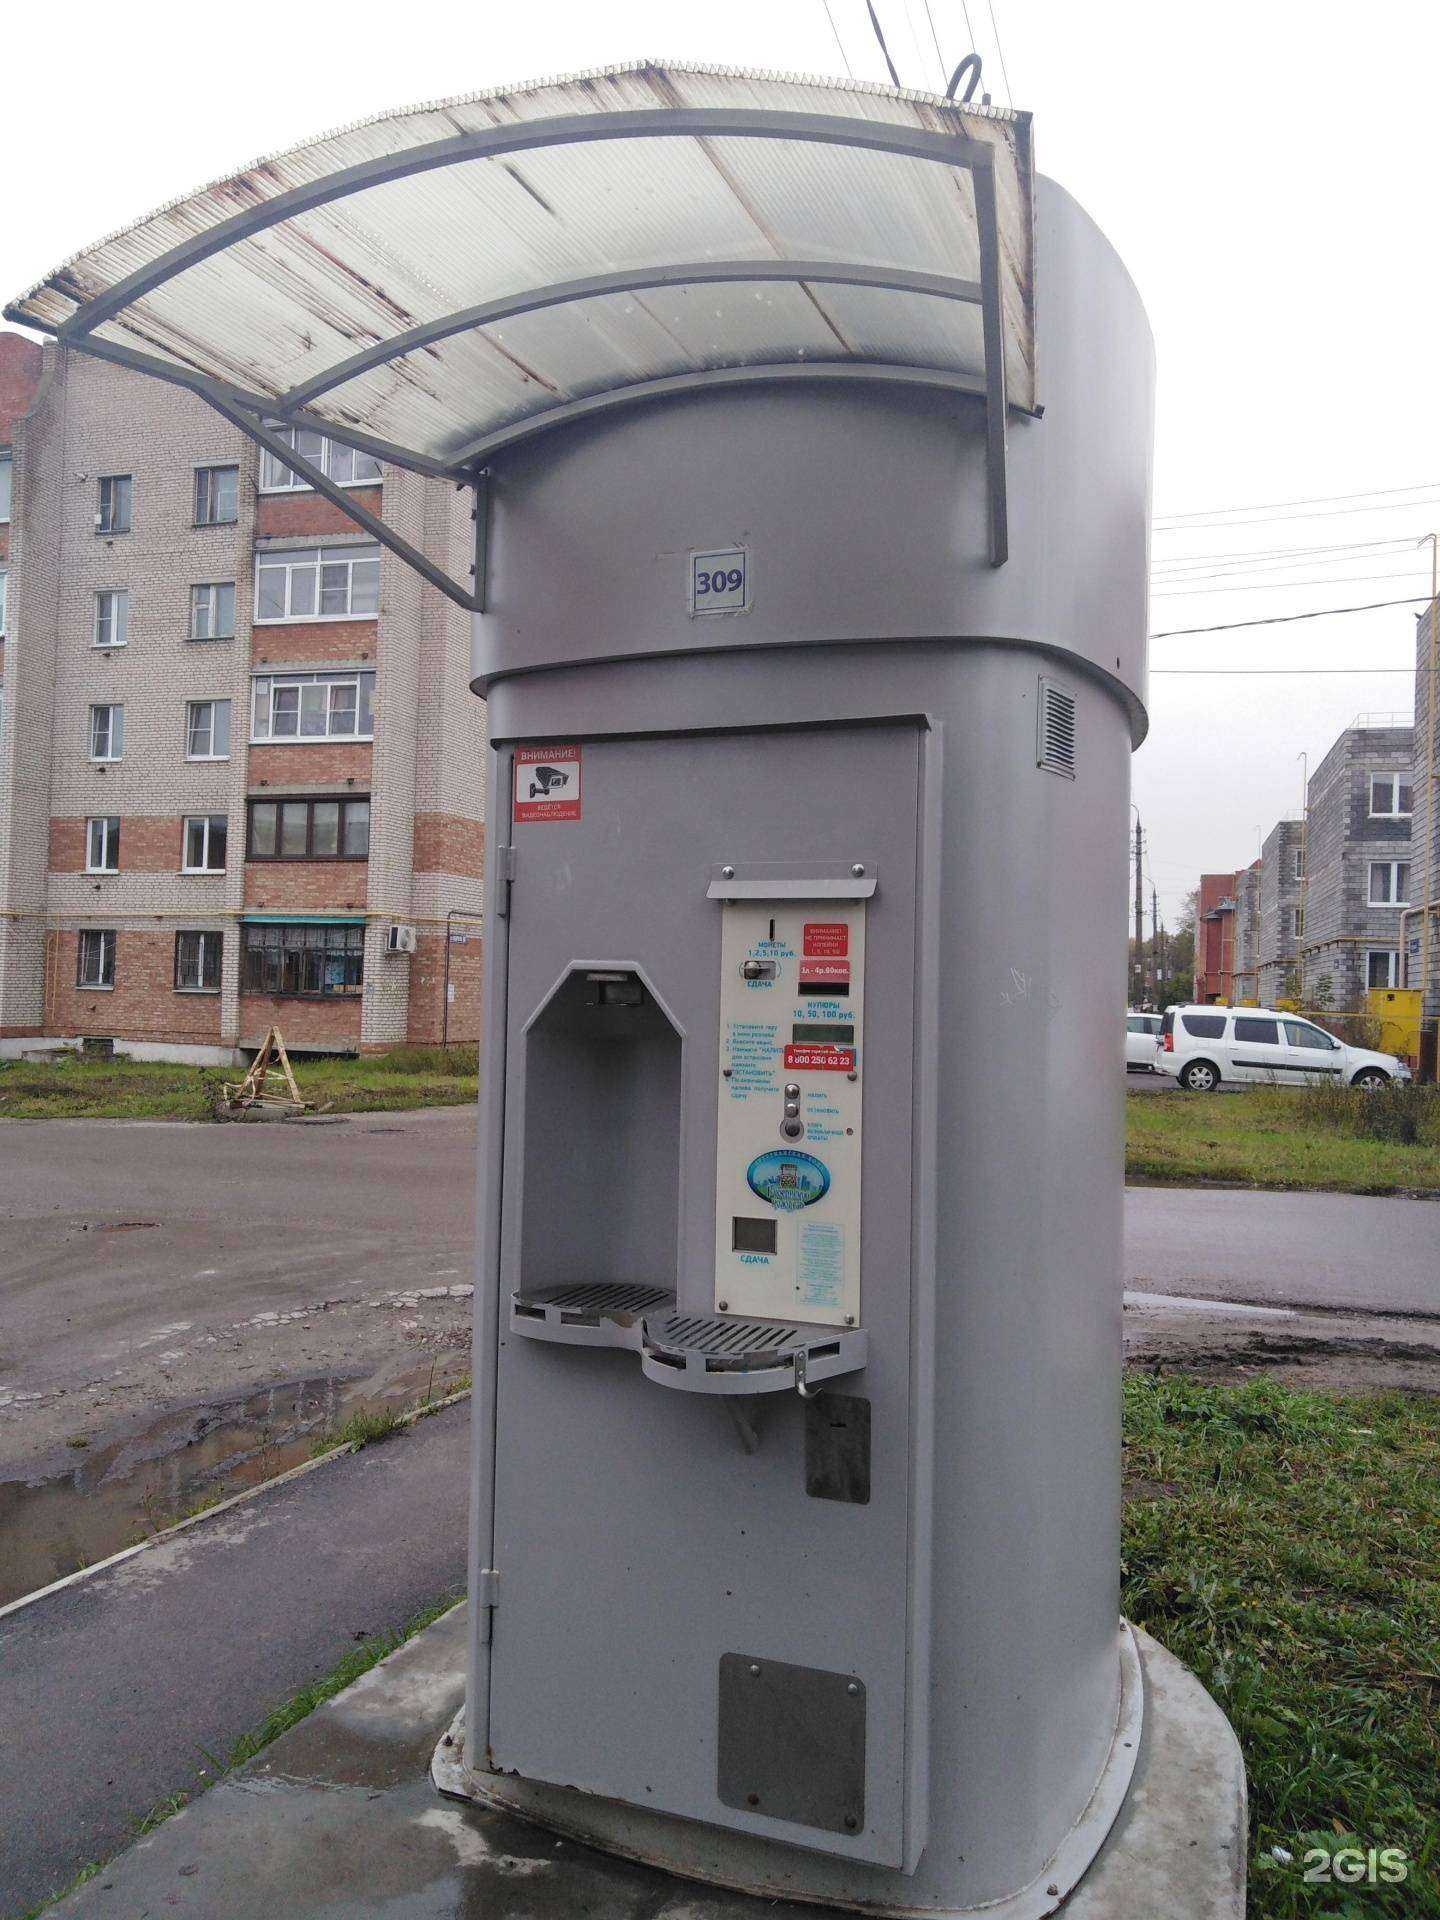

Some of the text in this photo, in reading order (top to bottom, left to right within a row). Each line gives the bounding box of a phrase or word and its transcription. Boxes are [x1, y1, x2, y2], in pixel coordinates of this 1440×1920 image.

[696, 569, 743, 595] 309
[521, 749, 576, 761] ВНИМАНИЕ!
[758, 941, 786, 949] МОНЕТЫ
[747, 980, 773, 988] СДАЧА
[807, 1001, 840, 1009] КУПЮРЫ
[838, 1011, 855, 1020] руб.
[787, 1055, 794, 1064] 8
[794, 1055, 810, 1064] 800
[827, 1056, 839, 1065] 62
[839, 1057, 851, 1066] 23
[740, 1254, 770, 1265] СДАЧА
